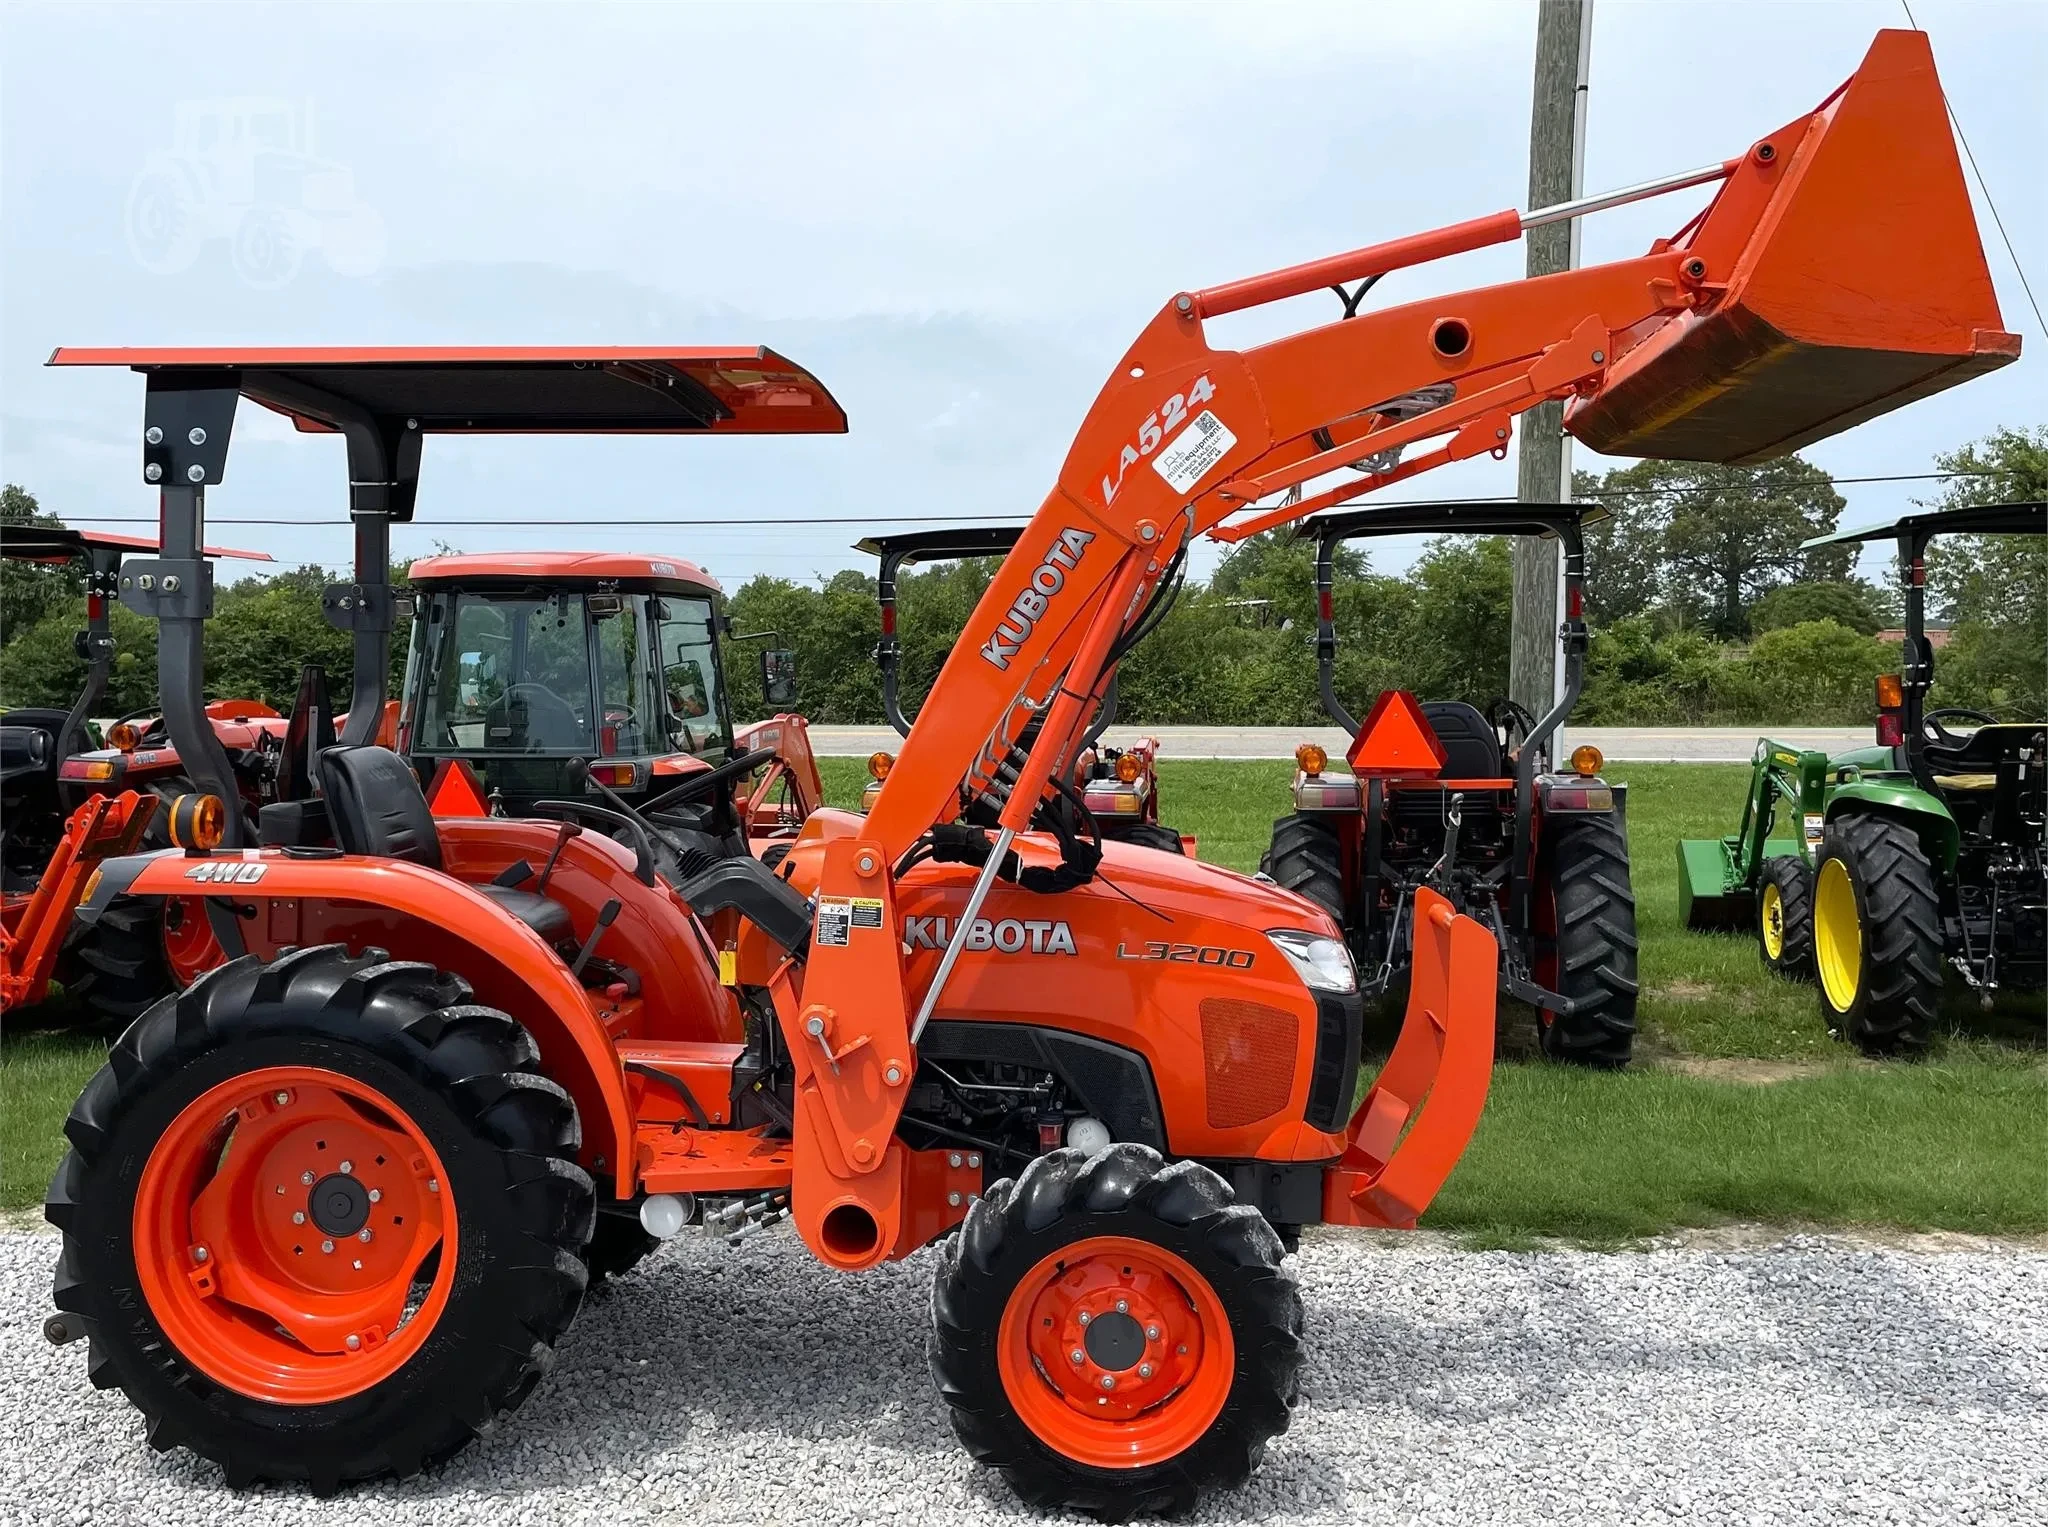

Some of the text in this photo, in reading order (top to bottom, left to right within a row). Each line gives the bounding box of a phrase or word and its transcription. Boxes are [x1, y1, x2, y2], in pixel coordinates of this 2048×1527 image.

[1102, 375, 1217, 506] LA524
[1167, 424, 1222, 479] millerequipment
[1181, 459, 1198, 475] TRUCK
[1197, 445, 1212, 459] SALES
[1211, 435, 1221, 446] LLC
[980, 527, 1096, 671] KUBOTA
[184, 862, 268, 884] 4WD
[904, 916, 1078, 955] KUBOTA
[1117, 942, 1256, 969] L3200
